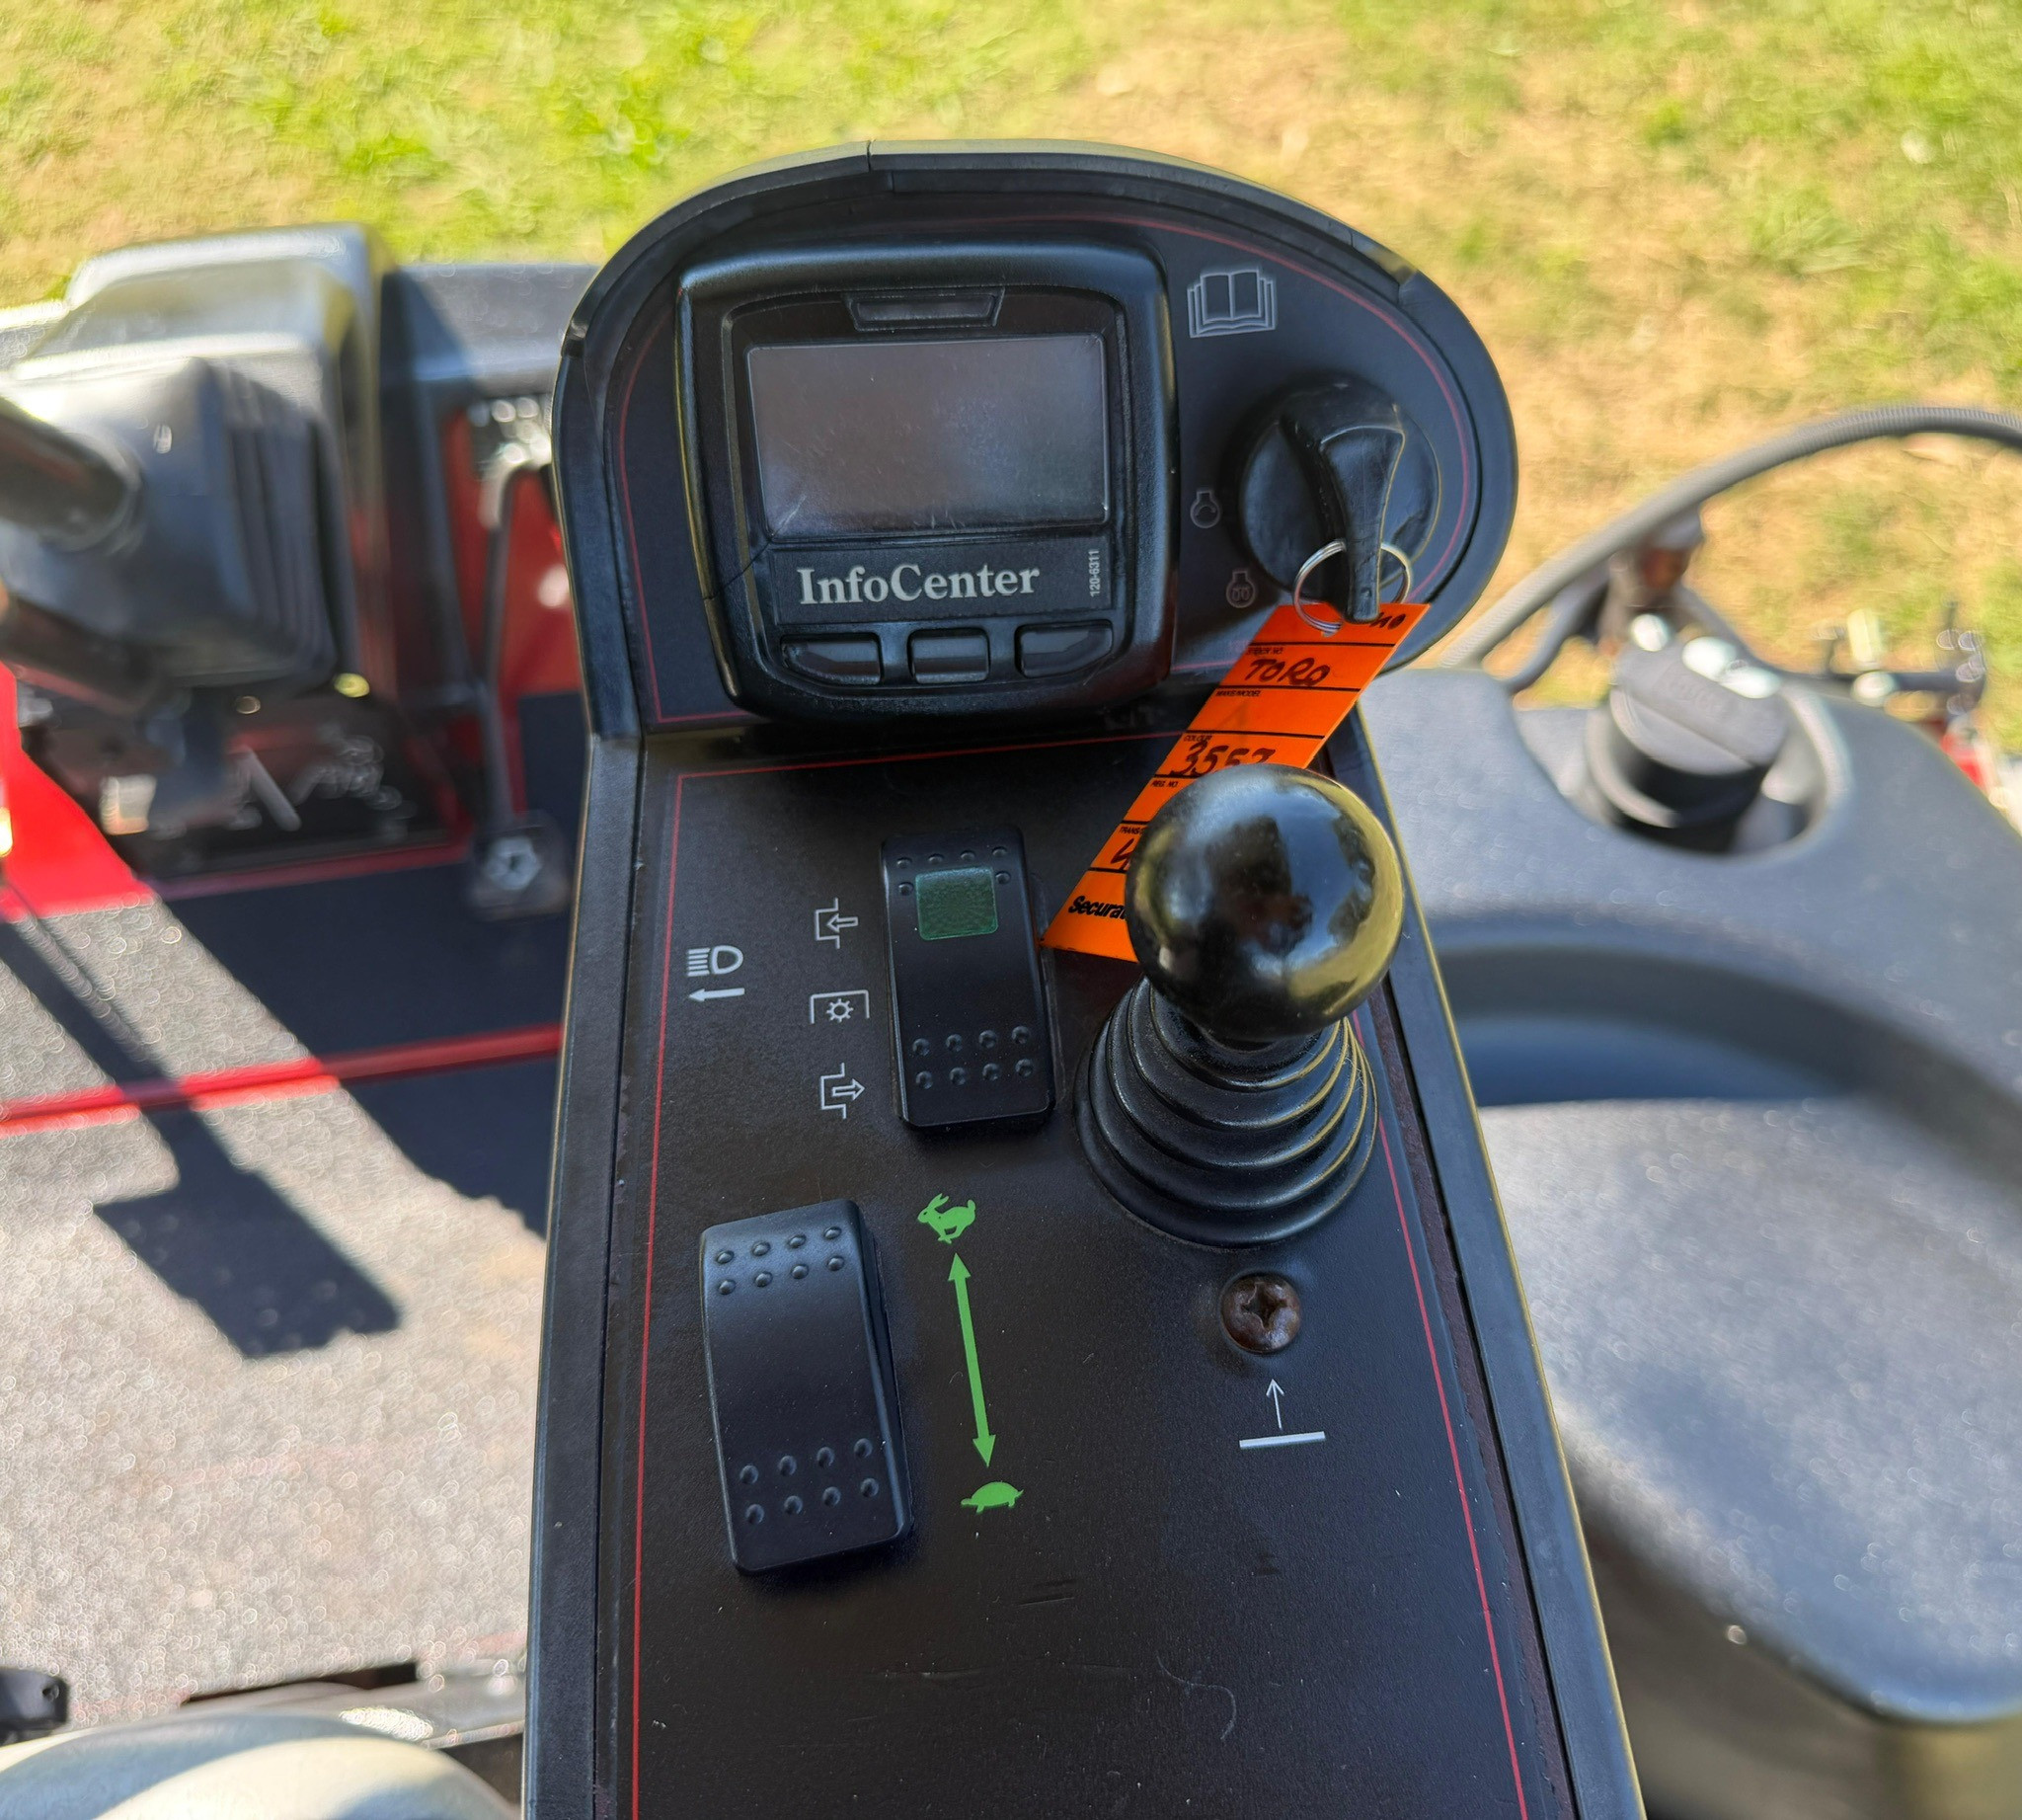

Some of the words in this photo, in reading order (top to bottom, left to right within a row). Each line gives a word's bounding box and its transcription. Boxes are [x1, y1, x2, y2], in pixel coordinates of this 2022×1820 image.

[797, 563, 1040, 605] InfoCenter
[1088, 549, 1100, 598] 120-6311
[1244, 657, 1331, 686] TORO
